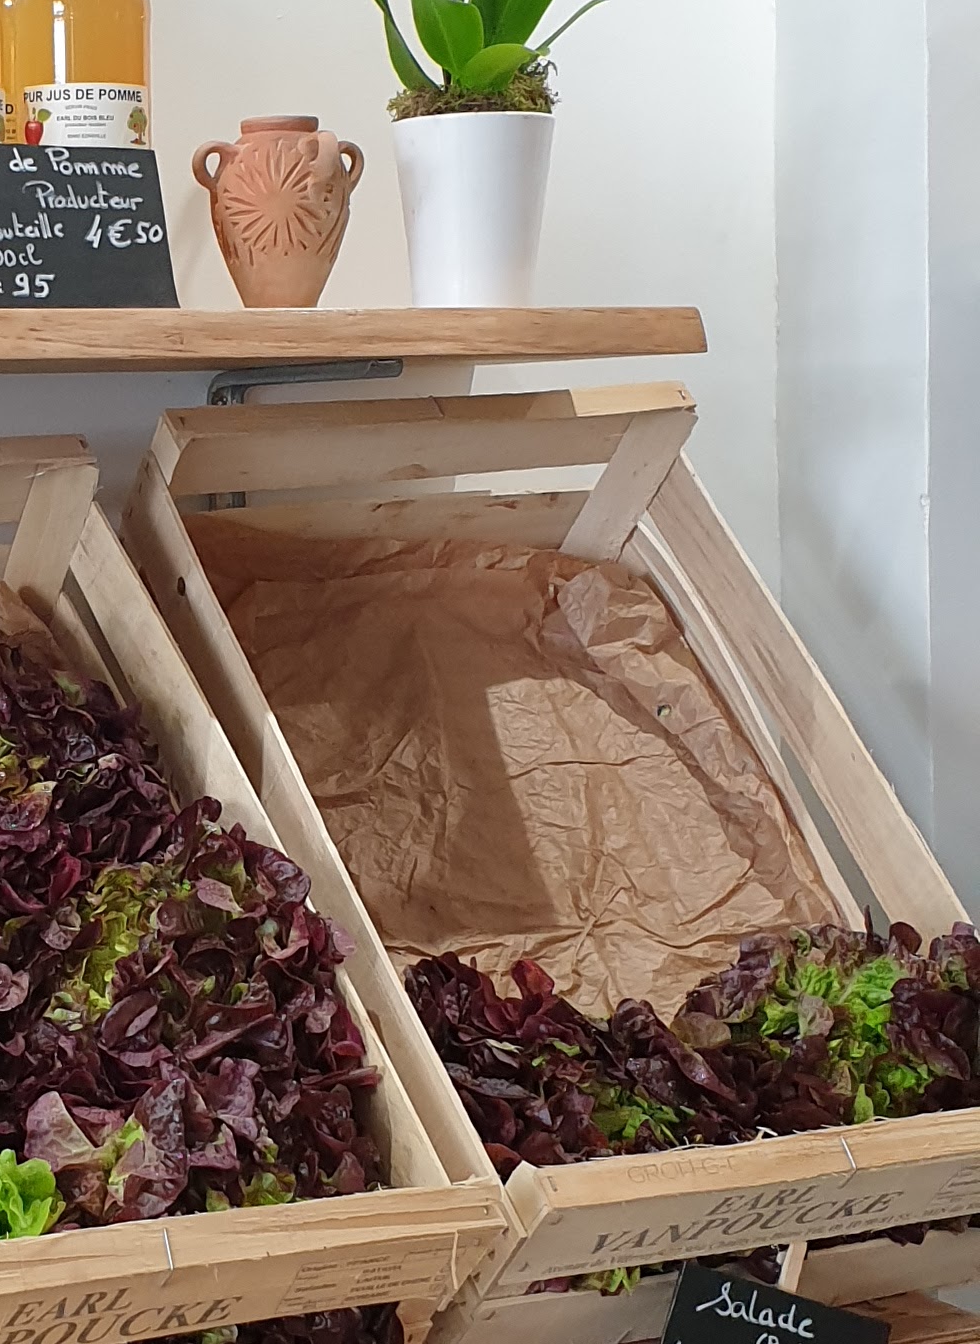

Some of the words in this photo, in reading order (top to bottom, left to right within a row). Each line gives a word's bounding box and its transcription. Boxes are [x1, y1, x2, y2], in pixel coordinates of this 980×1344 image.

[23, 90, 43, 104] PUR
[46, 89, 71, 101] JUS
[75, 88, 94, 100] DE
[98, 88, 143, 103] POMME
[8, 147, 38, 173] de
[44, 146, 144, 178] Pomme
[21, 180, 144, 211] Producteur
[11, 272, 56, 299] 95
[705, 1184, 819, 1218] EARL
[590, 1191, 905, 1255] VANPOUCKE
[2, 1286, 133, 1331] EARL
[695, 1281, 816, 1339] Salade
